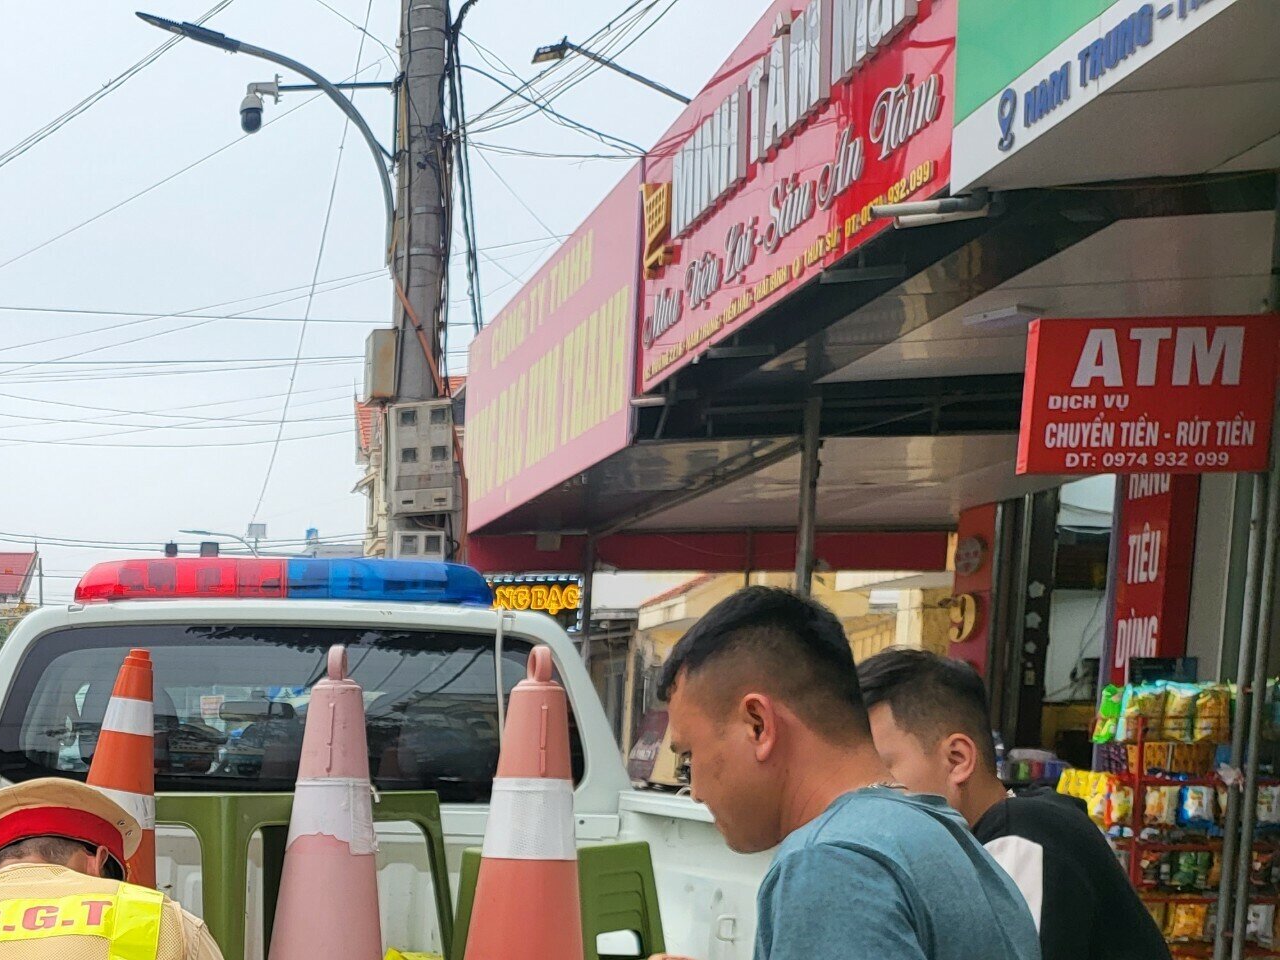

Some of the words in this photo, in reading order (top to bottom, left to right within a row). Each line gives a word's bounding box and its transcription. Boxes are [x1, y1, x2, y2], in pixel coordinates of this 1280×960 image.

[1023, 61, 1071, 128] NAM
[1078, 3, 1154, 88] TRUNG
[673, 88, 740, 240] MINH
[747, 0, 822, 166] TÂM
[685, 251, 720, 310] Tiện
[723, 215, 754, 285] Lợi
[816, 122, 864, 211] An
[869, 73, 938, 161] Tâm
[1071, 326, 1246, 388] ATM
[1045, 412, 1115, 448] CHUYỂN
[1120, 412, 1159, 447] TIỀN
[1176, 414, 1211, 447] RÚT
[1216, 411, 1255, 446] TIỀN
[1048, 395, 1097, 412] DỊCH
[1103, 395, 1130, 411] VỤ
[1102, 452, 1148, 467] 0974
[1154, 452, 1188, 466] 932
[1194, 452, 1229, 466] 099
[1127, 521, 1161, 584] TIÊU
